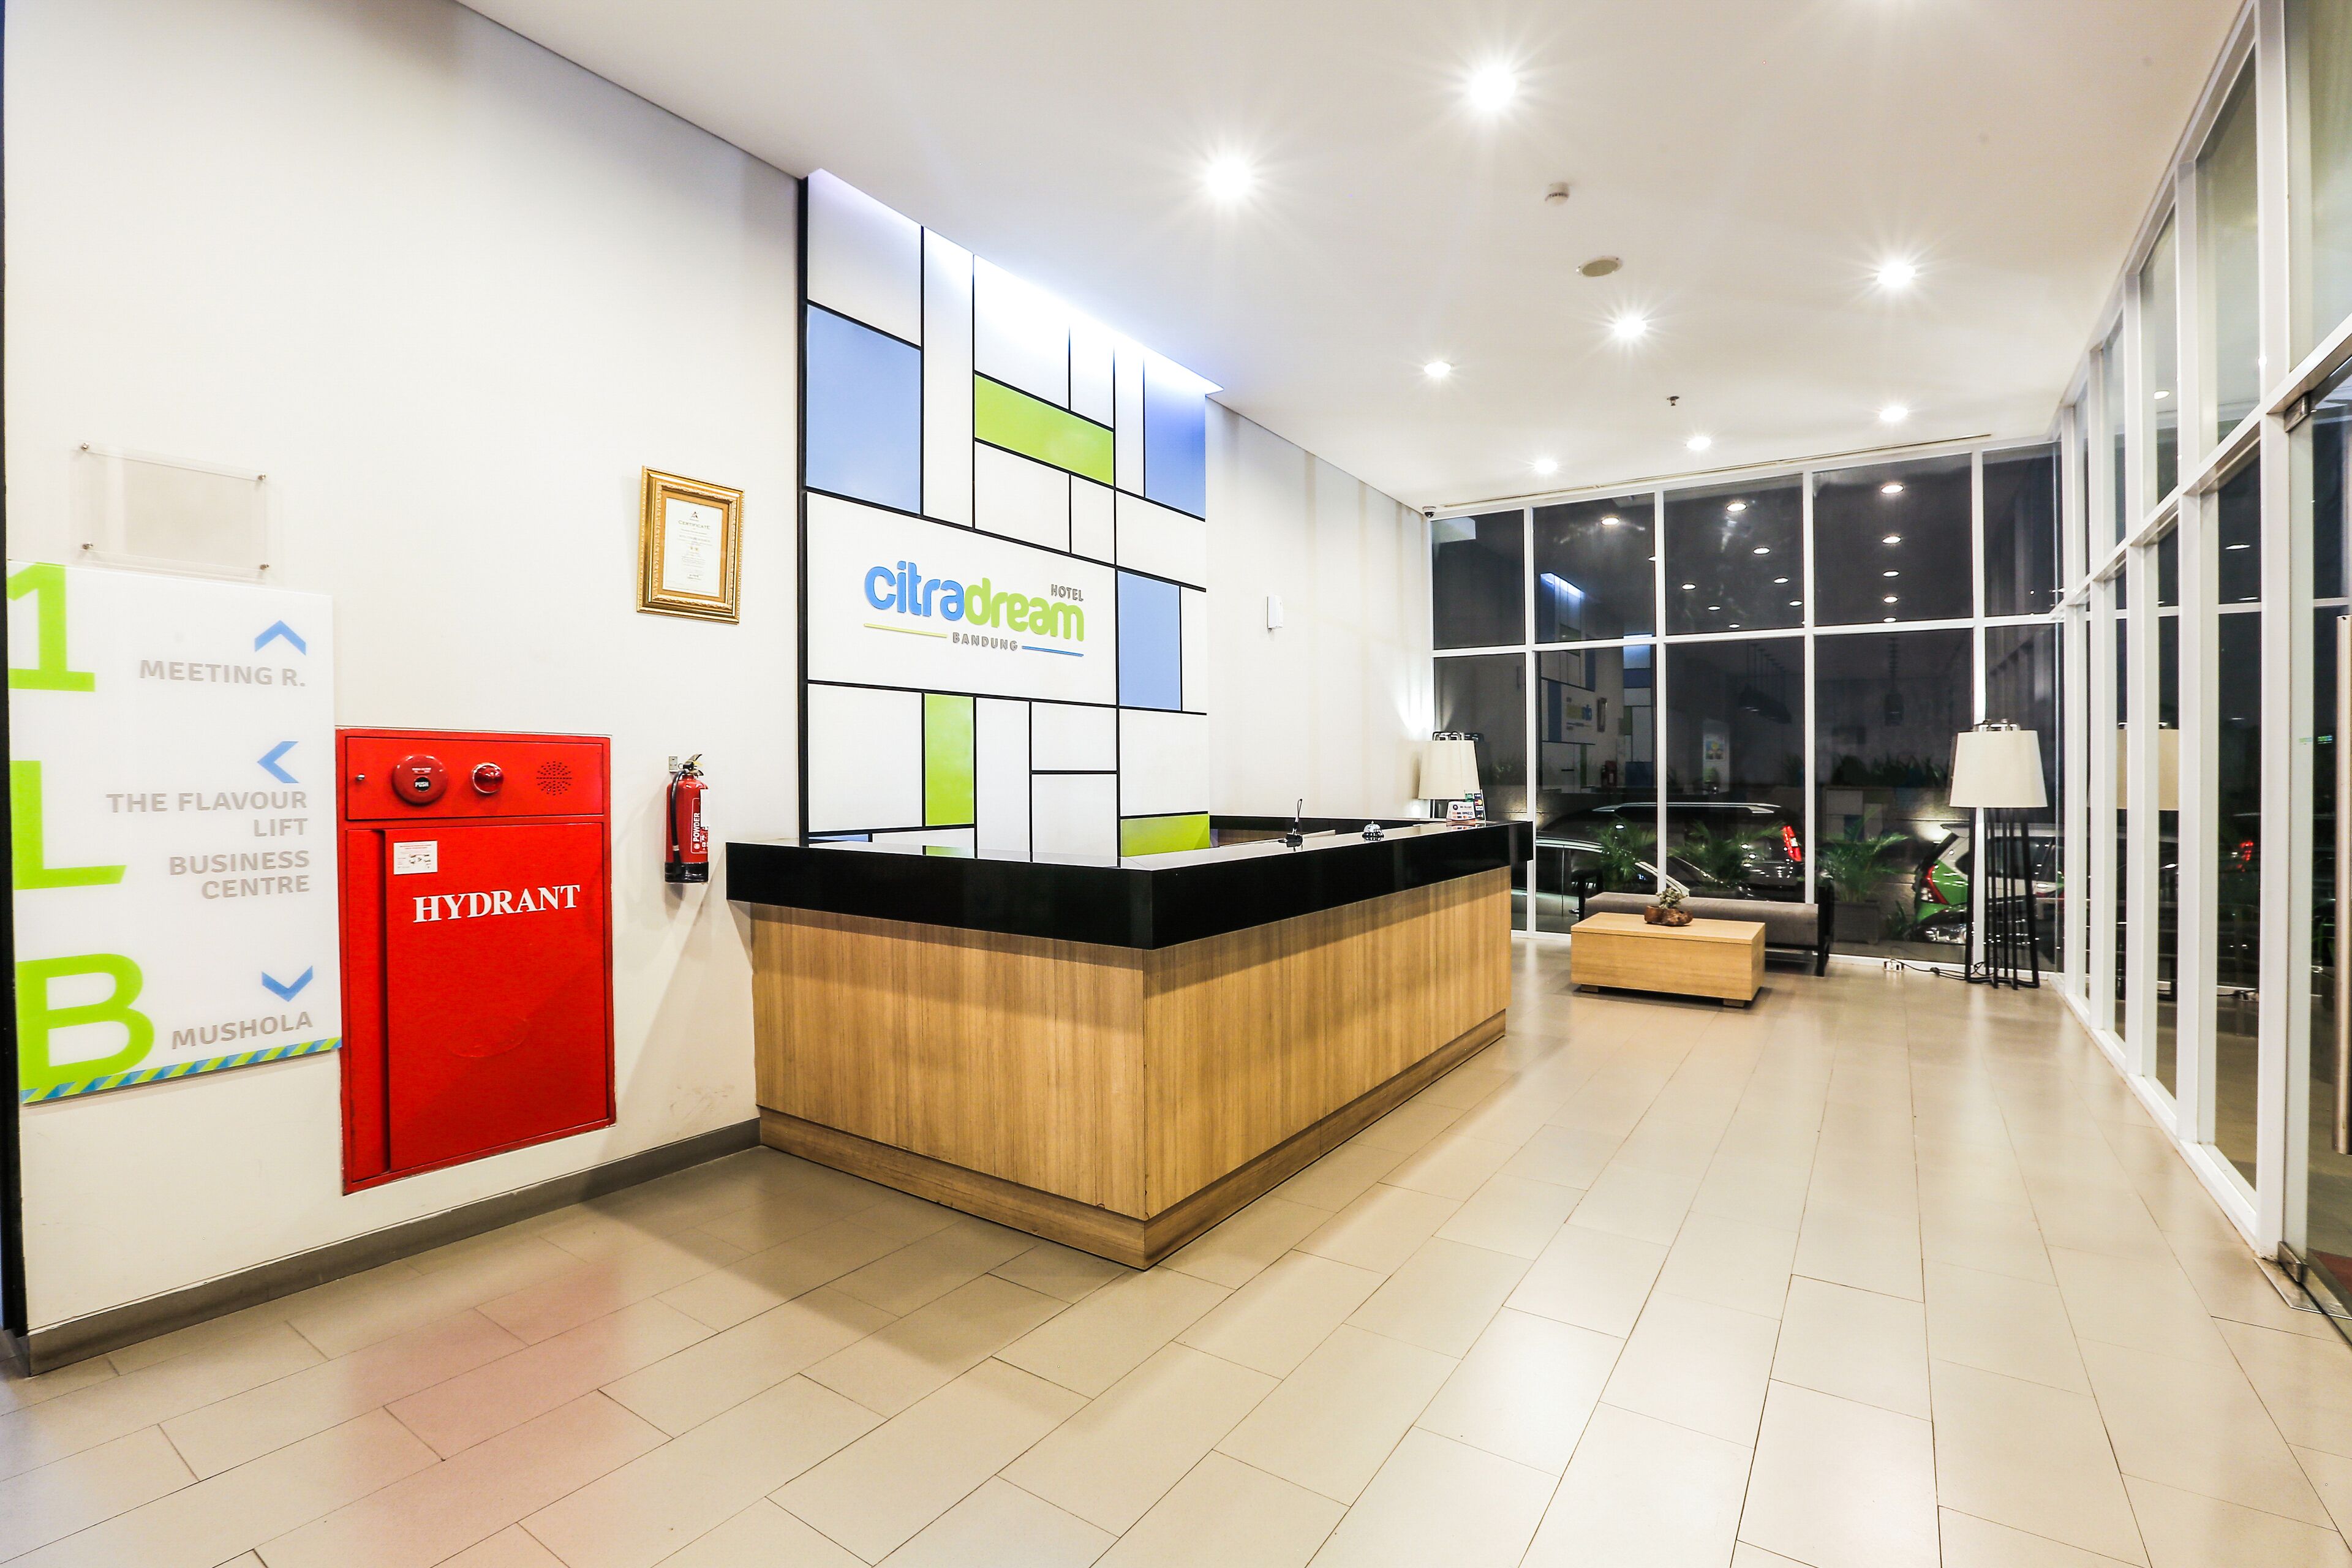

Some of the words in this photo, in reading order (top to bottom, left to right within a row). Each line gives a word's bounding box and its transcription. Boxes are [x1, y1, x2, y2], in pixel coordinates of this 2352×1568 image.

[678, 520, 710, 530] CERTIFICATE
[864, 560, 1084, 642] citradream
[1050, 584, 1084, 601] HOTEL
[7, 562, 96, 692] 1
[952, 631, 1018, 651] BANDUNG
[140, 659, 273, 686] MEETING
[282, 668, 306, 687] R.
[106, 793, 168, 813] THE
[178, 791, 307, 812] FLAVOUR
[9, 760, 127, 890] L
[254, 818, 308, 838] LIFT
[169, 850, 310, 875] BUSINESS
[202, 874, 310, 899] CENTRE
[413, 884, 580, 923] HYDRANT
[15, 953, 155, 1091] B
[172, 1011, 313, 1049] MUSHOLA
